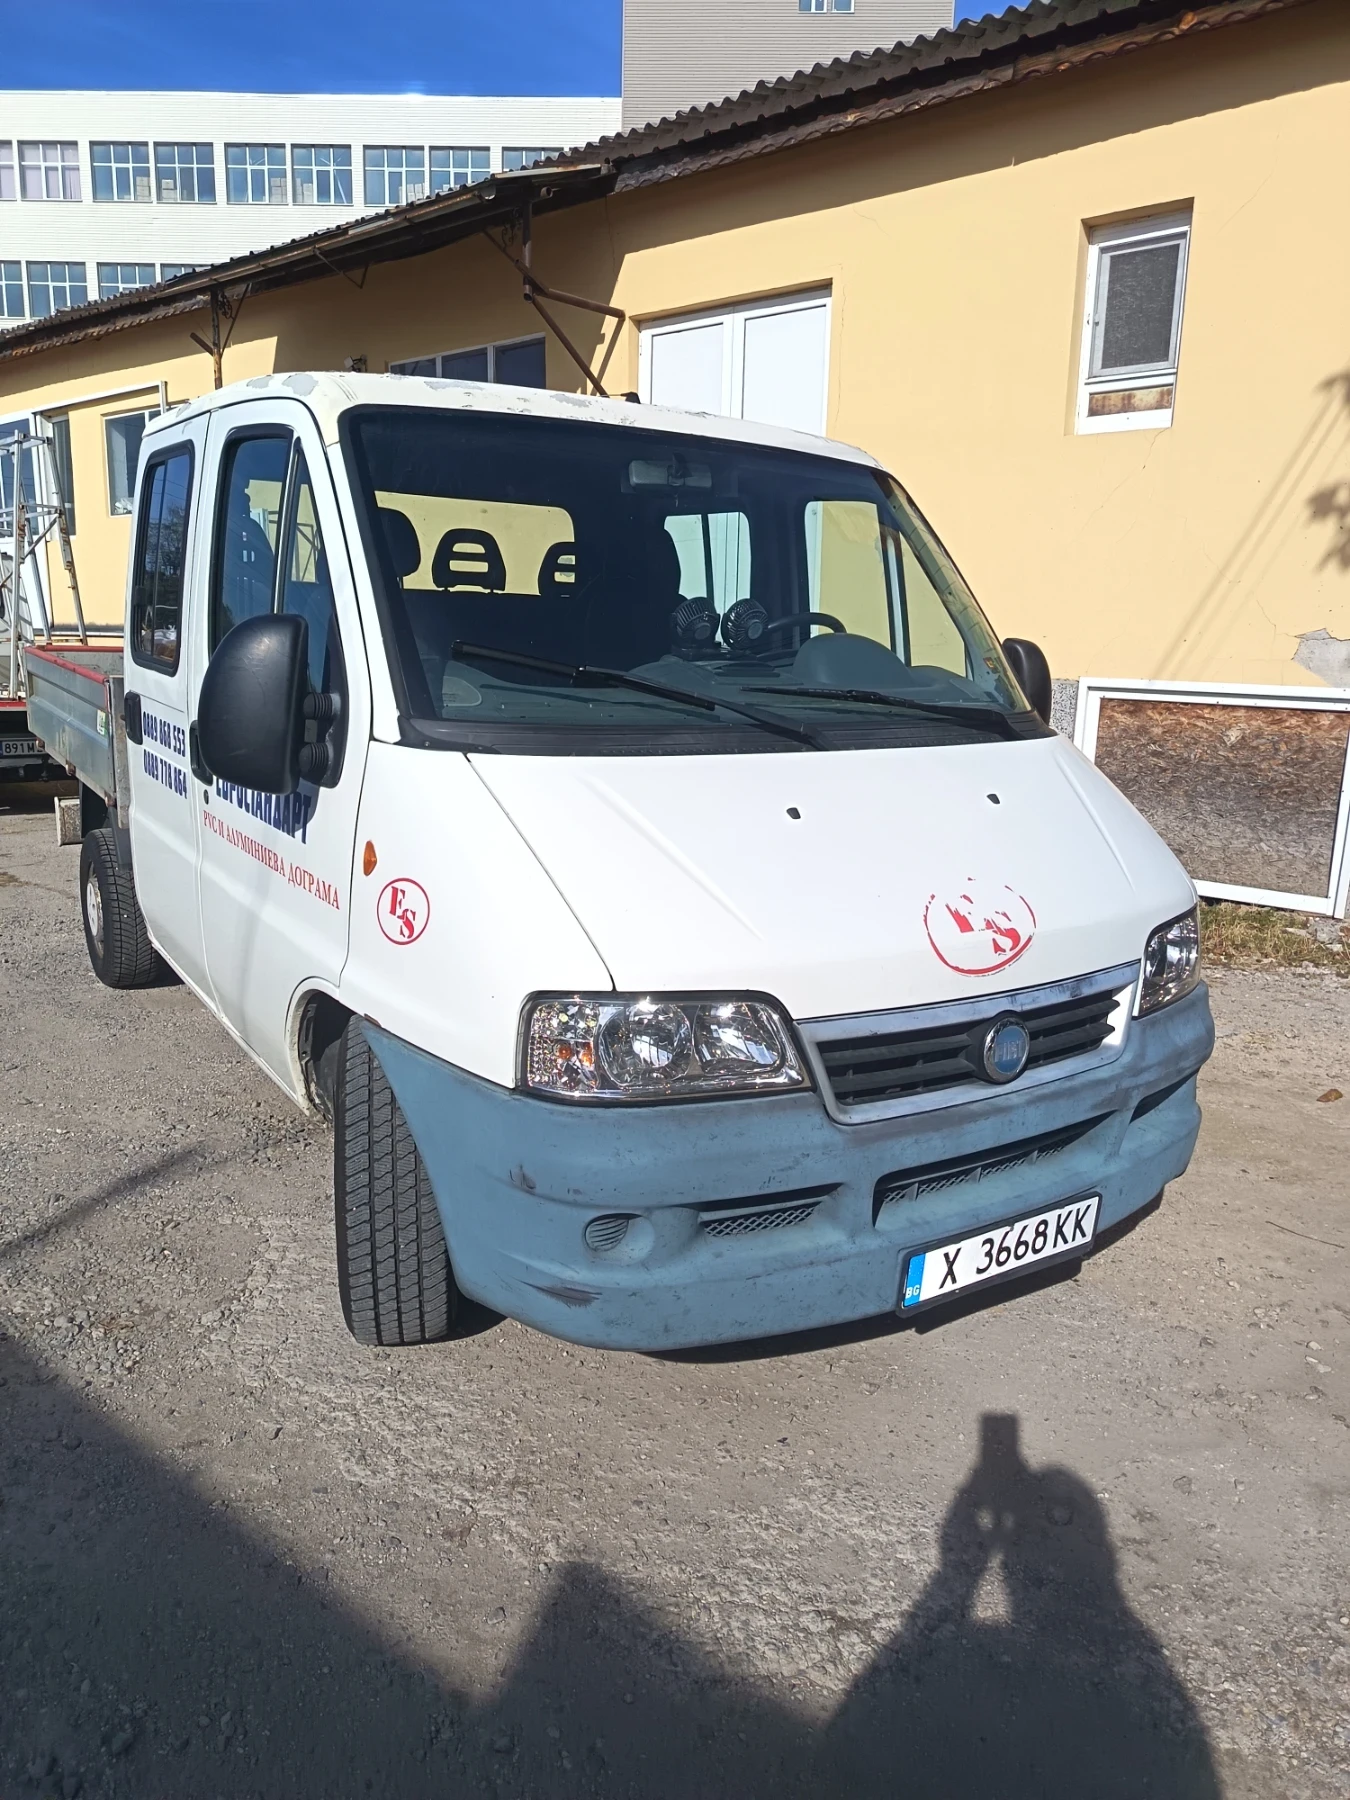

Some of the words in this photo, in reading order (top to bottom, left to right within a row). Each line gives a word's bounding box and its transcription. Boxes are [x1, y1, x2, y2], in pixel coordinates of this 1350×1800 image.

[4, 742, 43, 754] 891M
[172, 724, 186, 758] 553
[226, 824, 286, 878] АЛУМИНИЕВА
[287, 862, 341, 911] ДОГРАМА
[905, 1284, 920, 1299] BG
